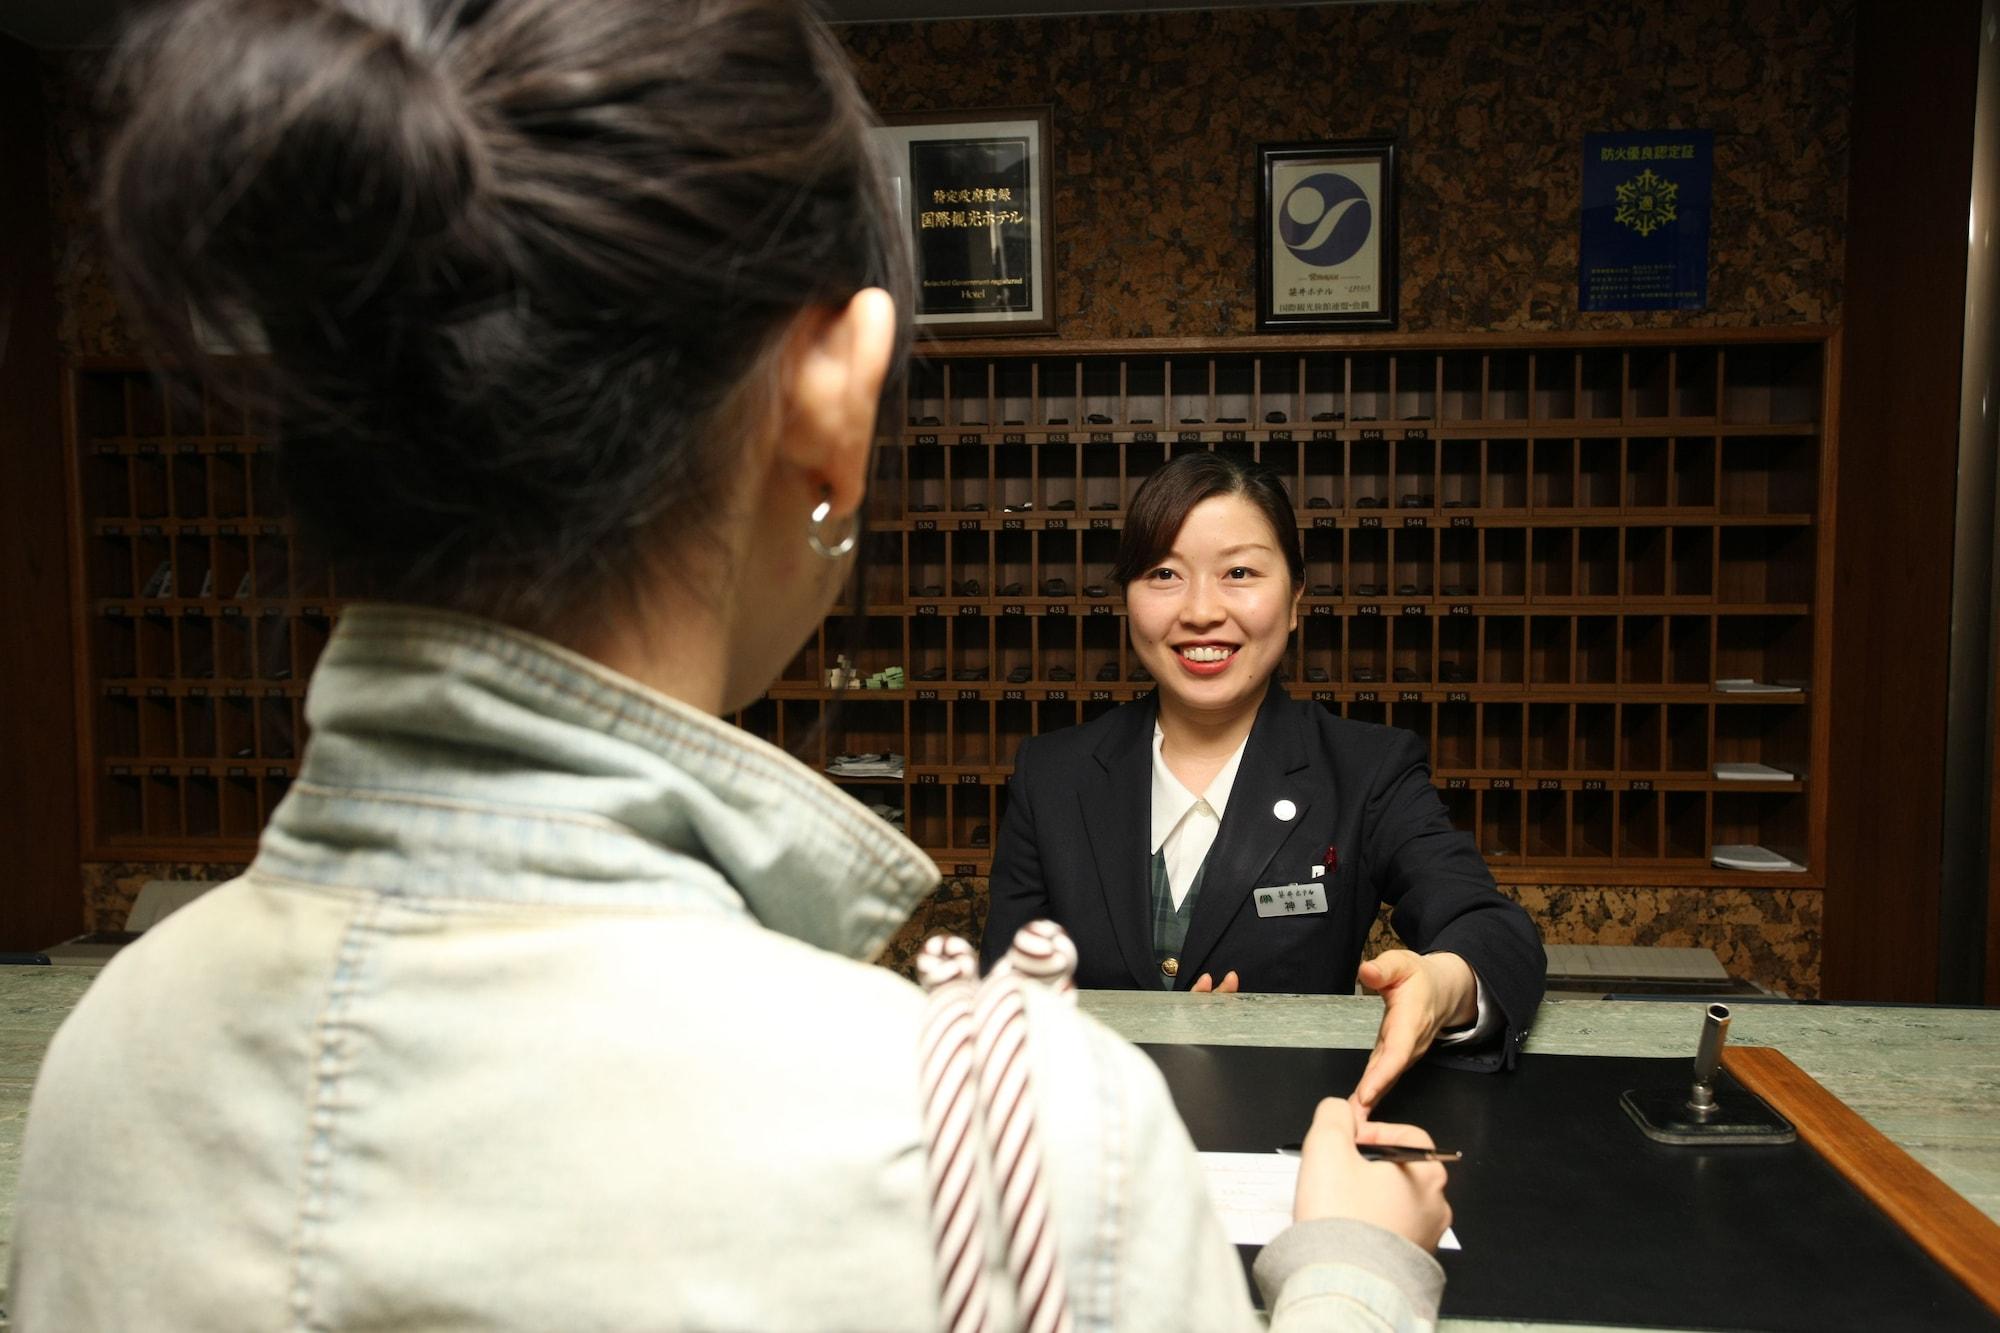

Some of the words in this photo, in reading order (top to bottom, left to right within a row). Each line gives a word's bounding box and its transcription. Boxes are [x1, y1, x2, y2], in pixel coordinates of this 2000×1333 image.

[921, 210, 1024, 228] 国際観光ホテル
[1180, 432, 1198, 441] 640
[1225, 432, 1242, 441] 641
[1271, 432, 1289, 440] 642
[1363, 430, 1380, 439] 644
[1407, 430, 1425, 439] 645
[918, 436, 936, 444] 630
[961, 435, 978, 444] 631
[917, 521, 934, 530] 530
[961, 520, 977, 529] 531
[1004, 520, 1022, 529] 532
[1047, 520, 1065, 529] 533
[1093, 520, 1110, 528] 534
[1315, 518, 1333, 527] 542
[1362, 518, 1379, 527] 543
[1406, 518, 1424, 527] 544
[918, 606, 936, 615] 430
[961, 606, 977, 615] 431
[1005, 606, 1022, 615] 432
[1049, 606, 1066, 615] 433
[1093, 606, 1110, 614] 434
[1313, 606, 1331, 615] 442
[1360, 606, 1378, 615] 443
[1451, 606, 1469, 615] 445
[919, 691, 936, 700] 330
[960, 691, 976, 700] 331
[1005, 691, 1023, 700] 332
[1048, 691, 1065, 700] 333
[1093, 690, 1110, 700] 334
[1314, 692, 1332, 701] 342
[1358, 692, 1376, 701] 343
[1401, 692, 1419, 701] 344
[1449, 692, 1466, 701] 345
[920, 775, 936, 784] 121
[960, 775, 977, 784] 122
[1449, 779, 1467, 788] 227
[1540, 780, 1558, 789] 230
[1584, 780, 1602, 789] 231
[1632, 781, 1650, 790] 232
